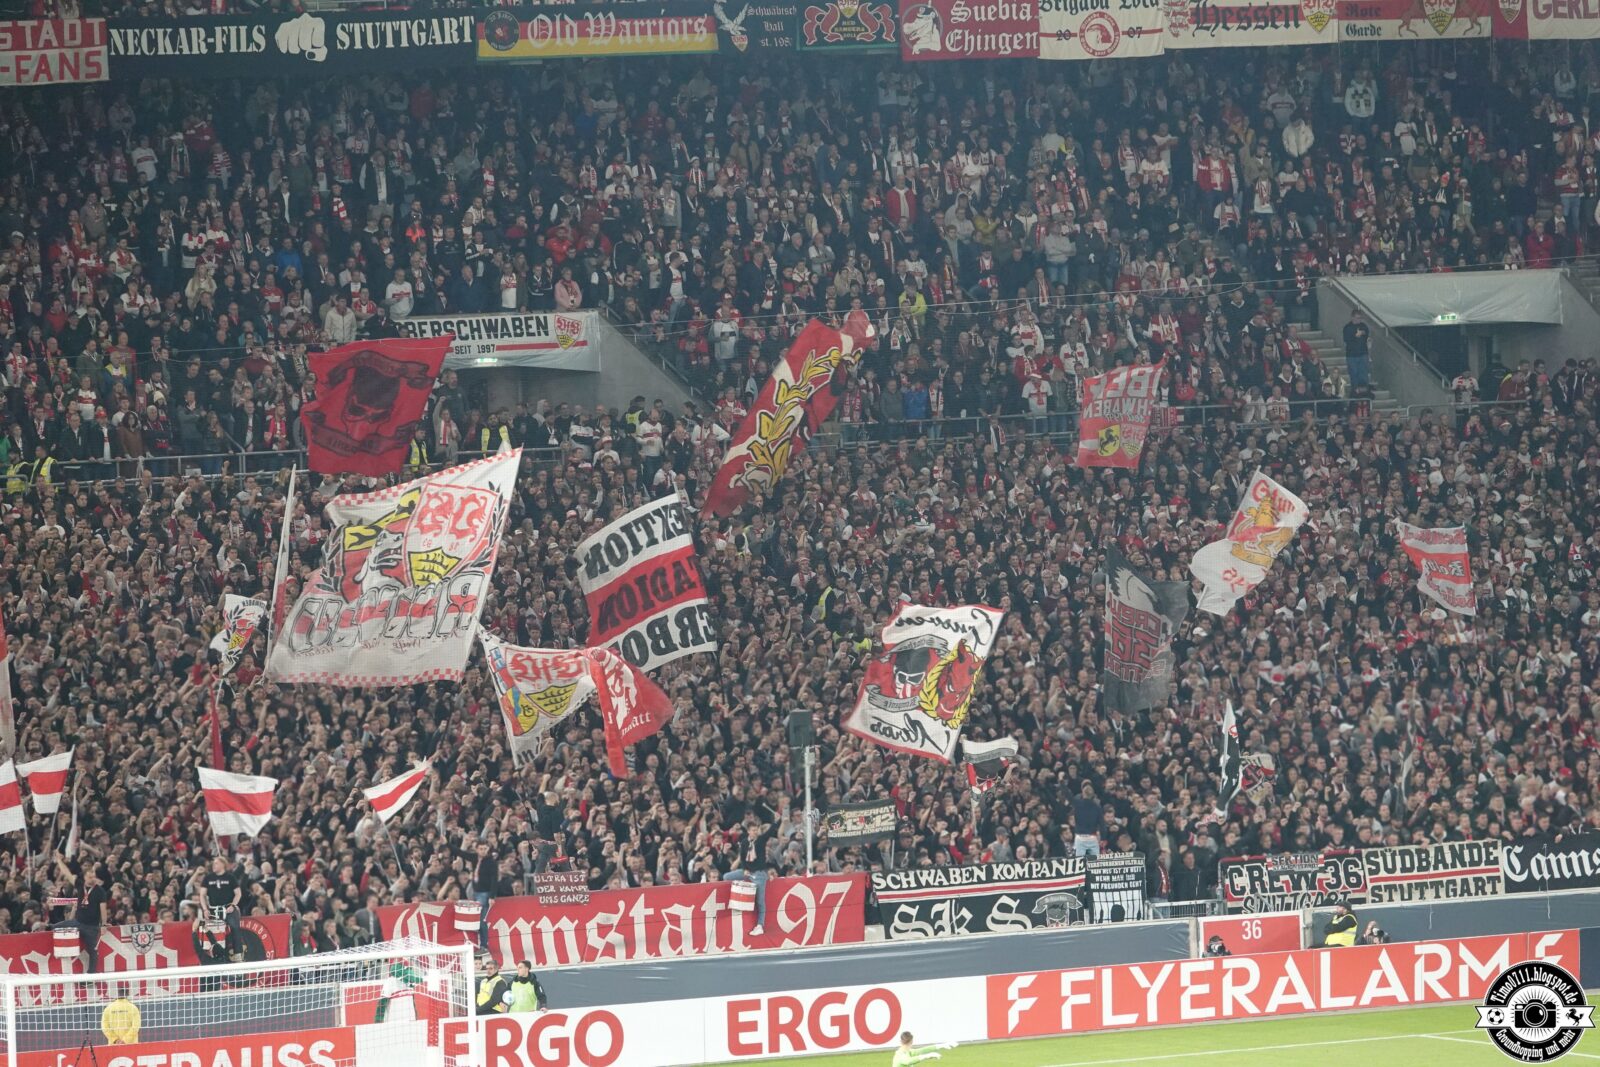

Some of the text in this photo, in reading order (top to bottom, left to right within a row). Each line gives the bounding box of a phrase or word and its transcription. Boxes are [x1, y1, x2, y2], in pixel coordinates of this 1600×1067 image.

[950, 0, 1033, 23] Suebia
[109, 24, 266, 56] NECKAR-FILS
[336, 15, 475, 50] STUTTGART
[527, 13, 579, 49] Old
[583, 9, 709, 47] Warriors
[945, 29, 1038, 56] Ehingen
[455, 344, 495, 355] SEIT 1997
[873, 857, 1086, 890] SCHWABEN KOMPANIE
[1364, 841, 1499, 876] SÜDBANDE
[534, 874, 566, 883] ULTRA
[537, 885, 556, 893] DER
[1227, 857, 1366, 898] CREW 36
[1370, 875, 1501, 904] STUTTGART
[539, 895, 558, 904] UMS
[391, 880, 858, 972] Cnnstatt 97
[1241, 919, 1262, 940] 36
[1061, 939, 1511, 1031] FLYERALARM
[727, 987, 902, 1056] ERGO
[443, 1010, 624, 1067] ERGO
